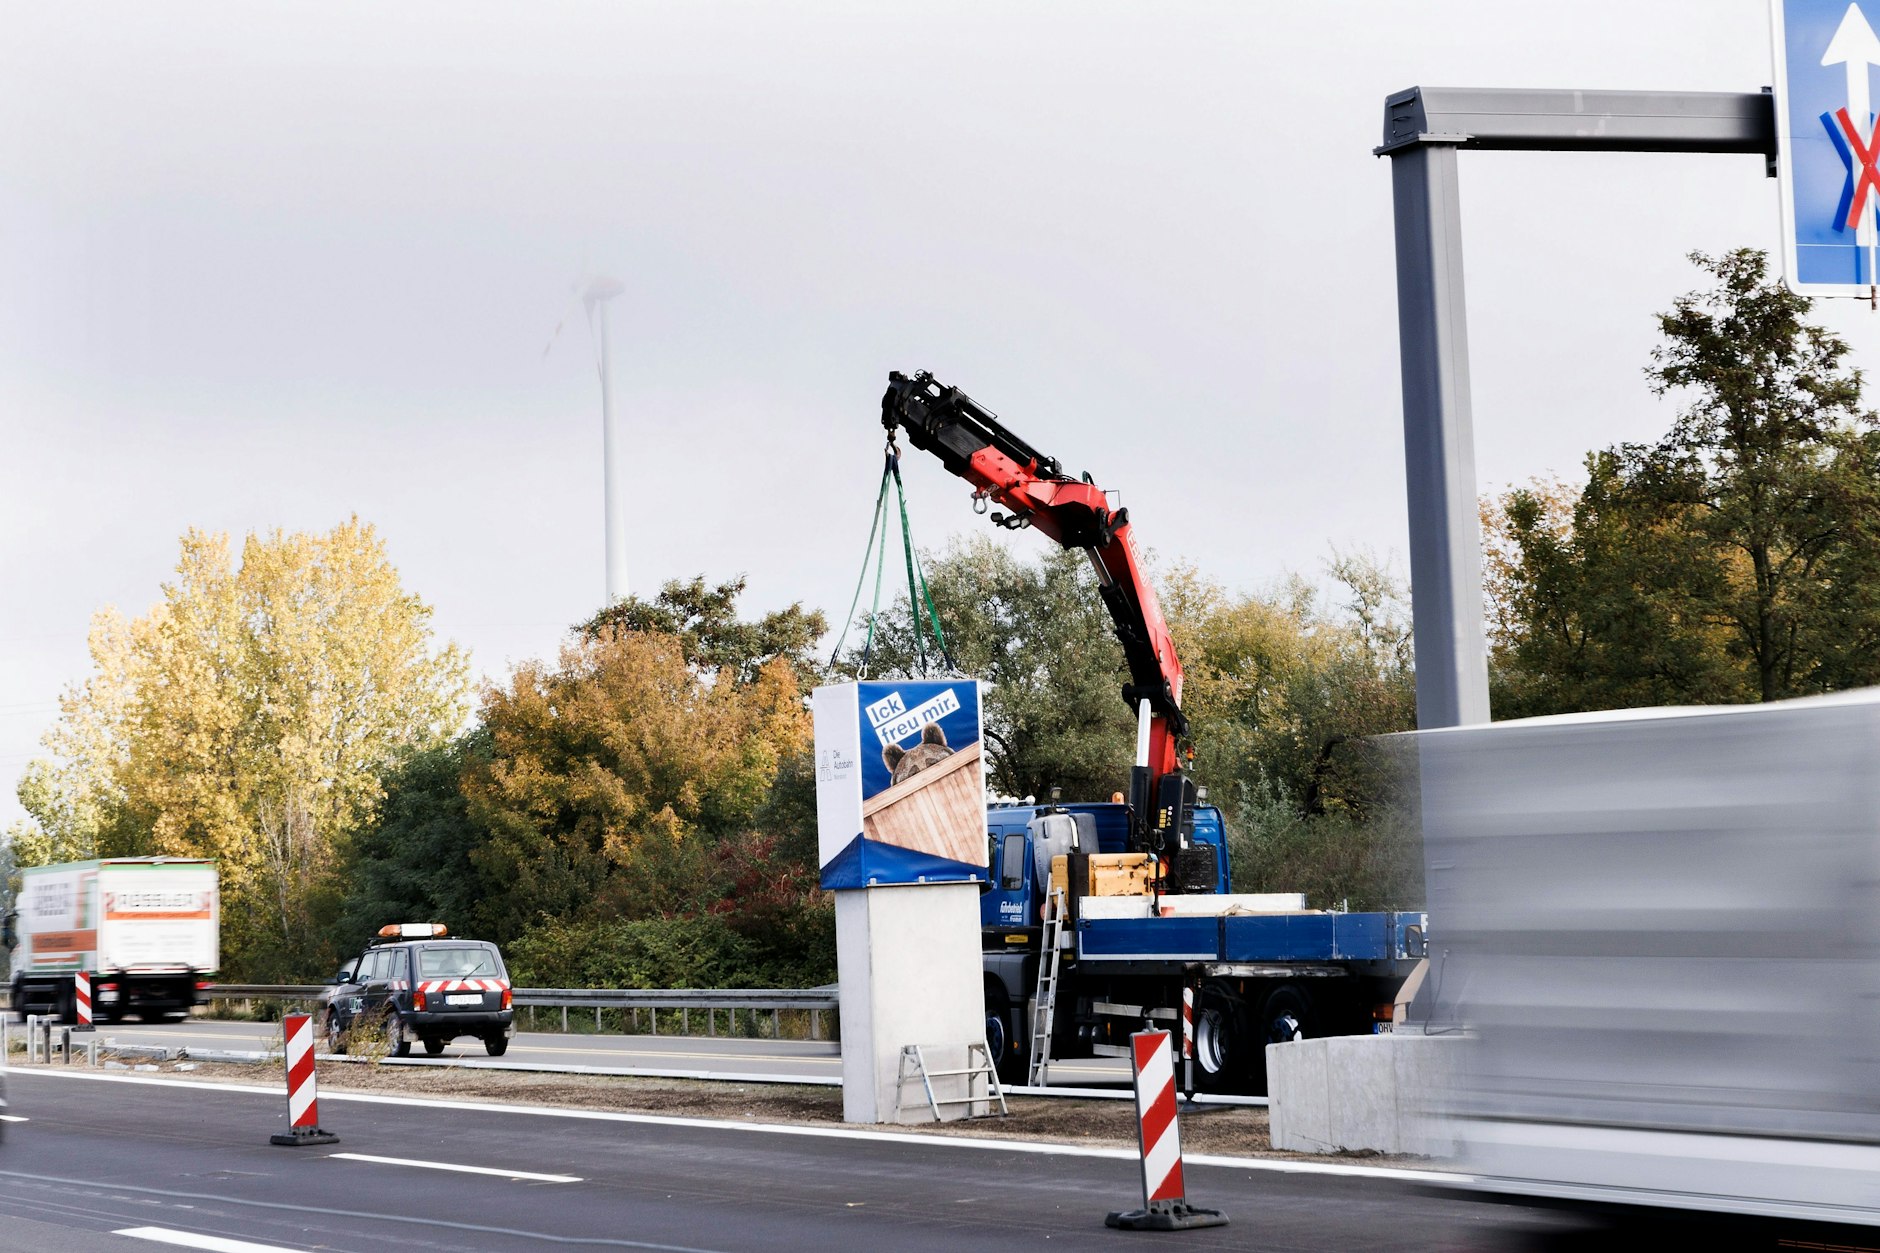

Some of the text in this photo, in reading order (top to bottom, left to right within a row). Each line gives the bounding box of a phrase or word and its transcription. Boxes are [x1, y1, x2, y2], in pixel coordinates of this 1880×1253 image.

[871, 698, 902, 722] Ick
[881, 698, 956, 744] freu mir.
